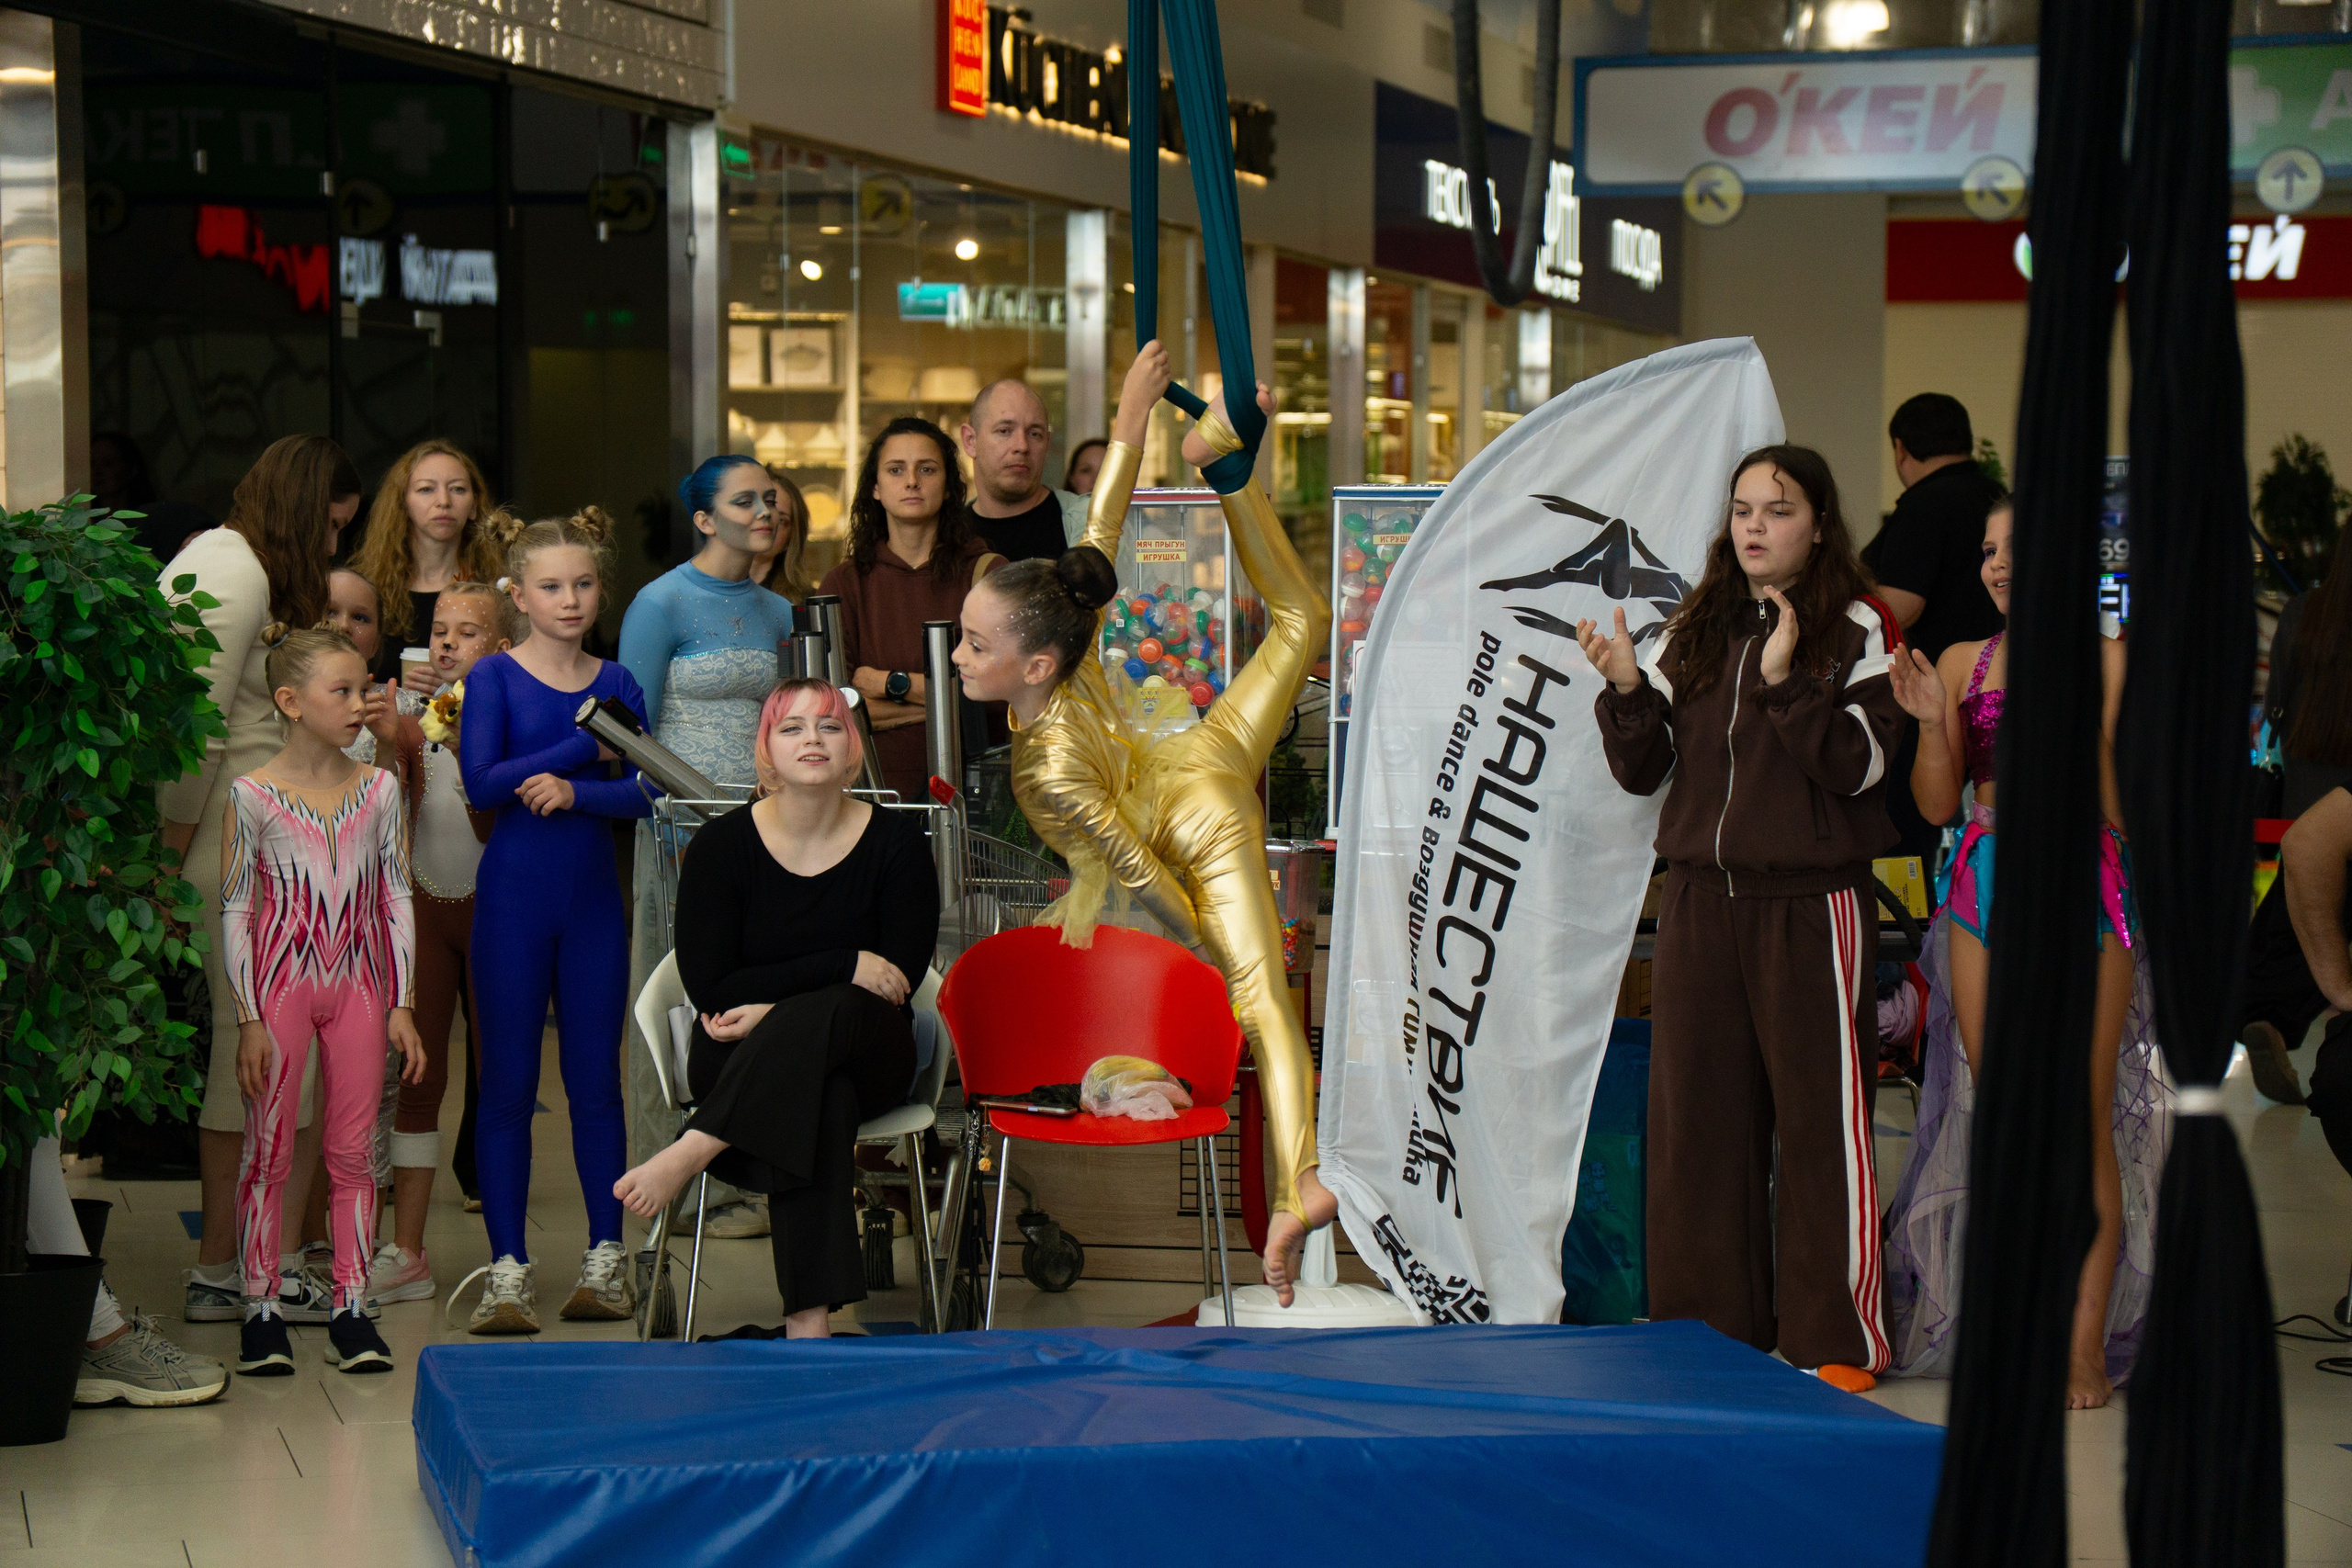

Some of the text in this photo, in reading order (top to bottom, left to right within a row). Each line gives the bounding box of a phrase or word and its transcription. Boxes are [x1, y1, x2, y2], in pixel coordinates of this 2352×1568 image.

[1143, 553, 1181, 561] ИГРУШКА
[1466, 630, 1502, 698] pole
[1436, 704, 1480, 793] dance
[1428, 797, 1451, 819] &
[1422, 653, 1571, 1218] НАШЕСТВИЕ
